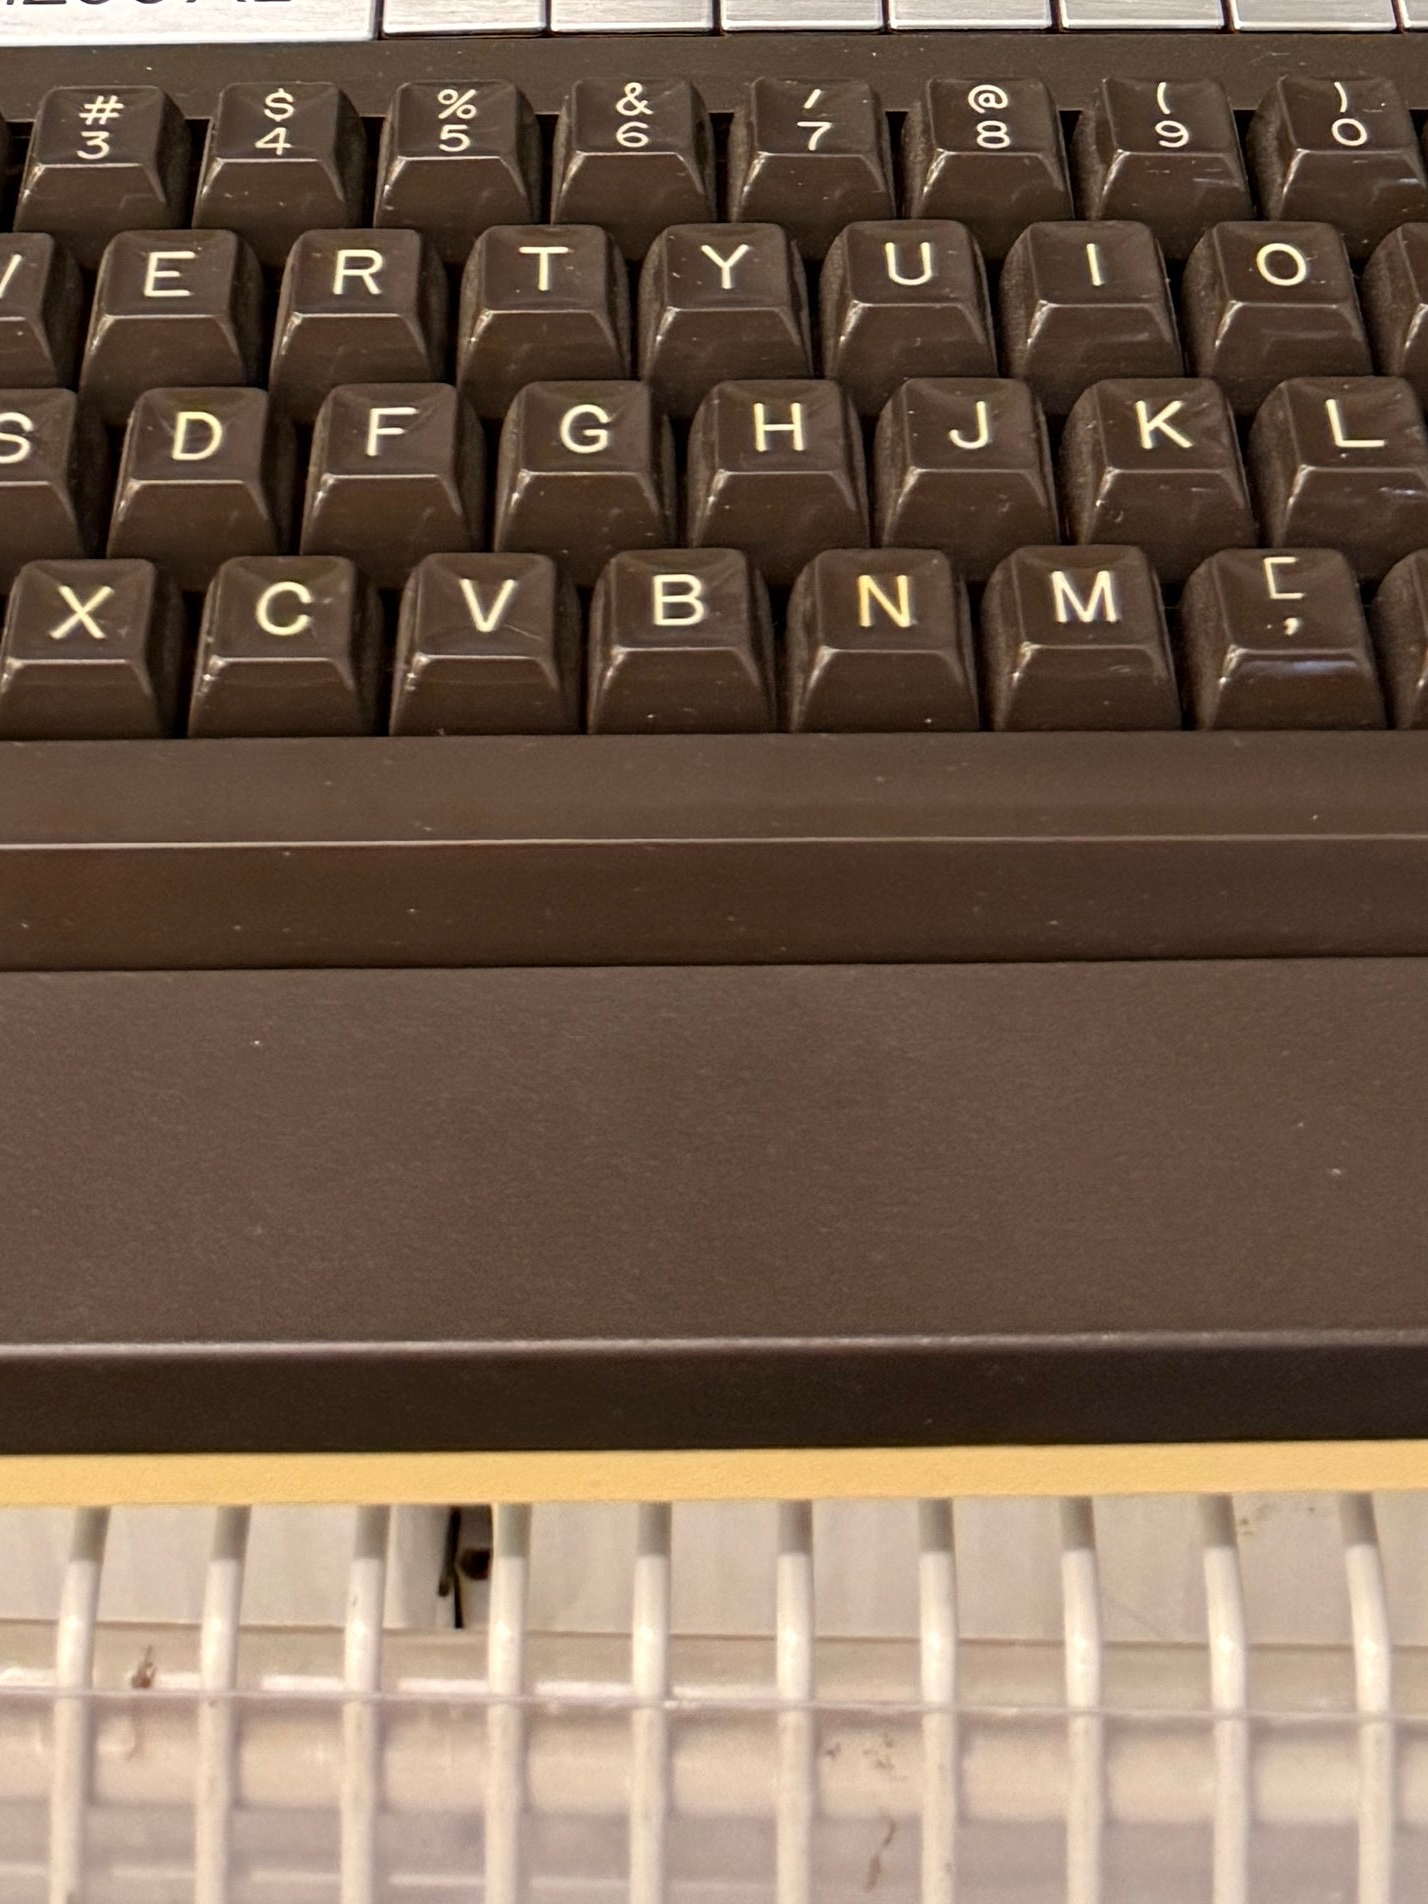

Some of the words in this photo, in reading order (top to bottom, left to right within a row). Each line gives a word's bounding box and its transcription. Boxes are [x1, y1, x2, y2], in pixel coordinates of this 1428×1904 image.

[80, 95, 124, 125] #
[264, 87, 294, 121] $
[437, 88, 477, 120] %
[615, 82, 654, 116] &
[968, 85, 1008, 113] @
[76, 131, 109, 160] 3
[255, 127, 292, 155] 4
[439, 125, 470, 152] 5
[615, 121, 649, 148] 6
[797, 121, 833, 151] 7
[976, 121, 1010, 149] 8
[1154, 121, 1190, 148] 9
[143, 250, 197, 297] E
[333, 248, 385, 295] R
[518, 245, 570, 292] T
[700, 243, 750, 290] Y
[884, 241, 932, 286] U
[1255, 242, 1308, 286] O
[171, 410, 223, 462] D
[364, 406, 420, 457] F
[559, 403, 611, 455] G
[753, 402, 806, 452] H
[947, 400, 991, 451] J
[1133, 399, 1196, 451] K
[1325, 398, 1386, 448] L
[48, 585, 115, 640] X
[255, 580, 312, 637] C
[459, 578, 518, 633] V
[651, 572, 706, 627] B
[856, 573, 915, 629] N
[1050, 569, 1120, 624] M
